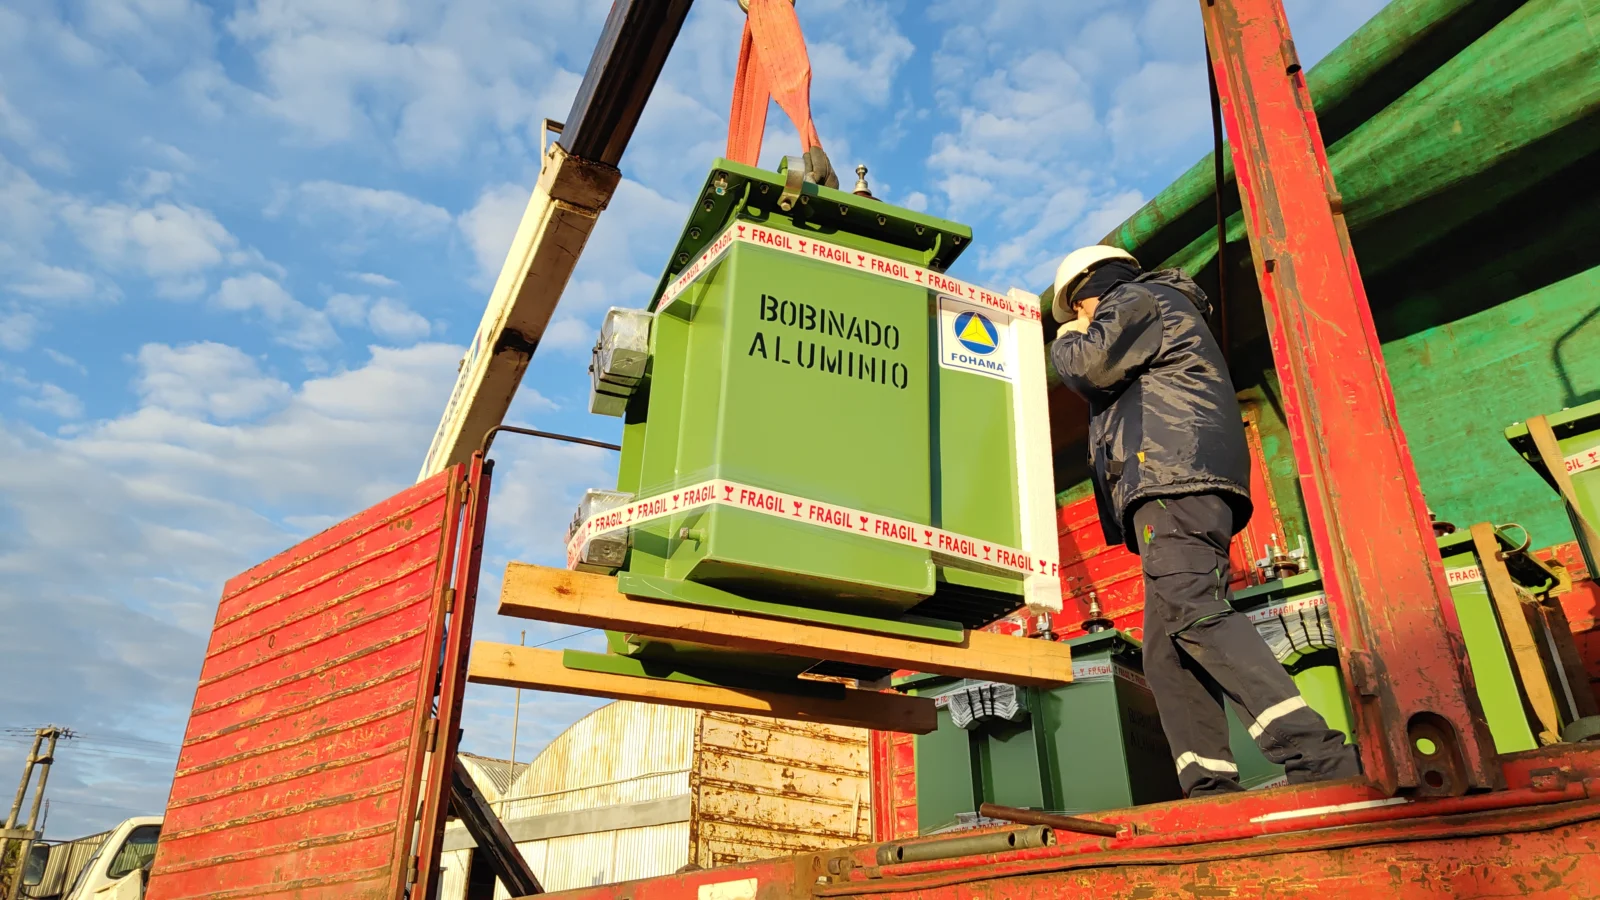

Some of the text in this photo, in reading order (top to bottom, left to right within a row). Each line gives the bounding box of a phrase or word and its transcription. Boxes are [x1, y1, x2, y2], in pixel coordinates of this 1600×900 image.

[710, 231, 732, 259] FRAGIL
[752, 229, 1014, 313] FRAGIL FRAGIL FRAGIL FRAGIL FRAGIL
[760, 294, 899, 350] BOBINADO
[748, 332, 908, 389] ALUMINIO
[951, 352, 1004, 372] FOHAMA
[595, 485, 716, 532] FRAGIL FRAGIL FRAGIL
[740, 489, 785, 513] FRAGIL
[809, 505, 852, 528] FRAGIL
[875, 520, 917, 542] FRAGIL
[938, 534, 977, 557] FRAGIL
[997, 549, 1034, 572] FRAGIL
